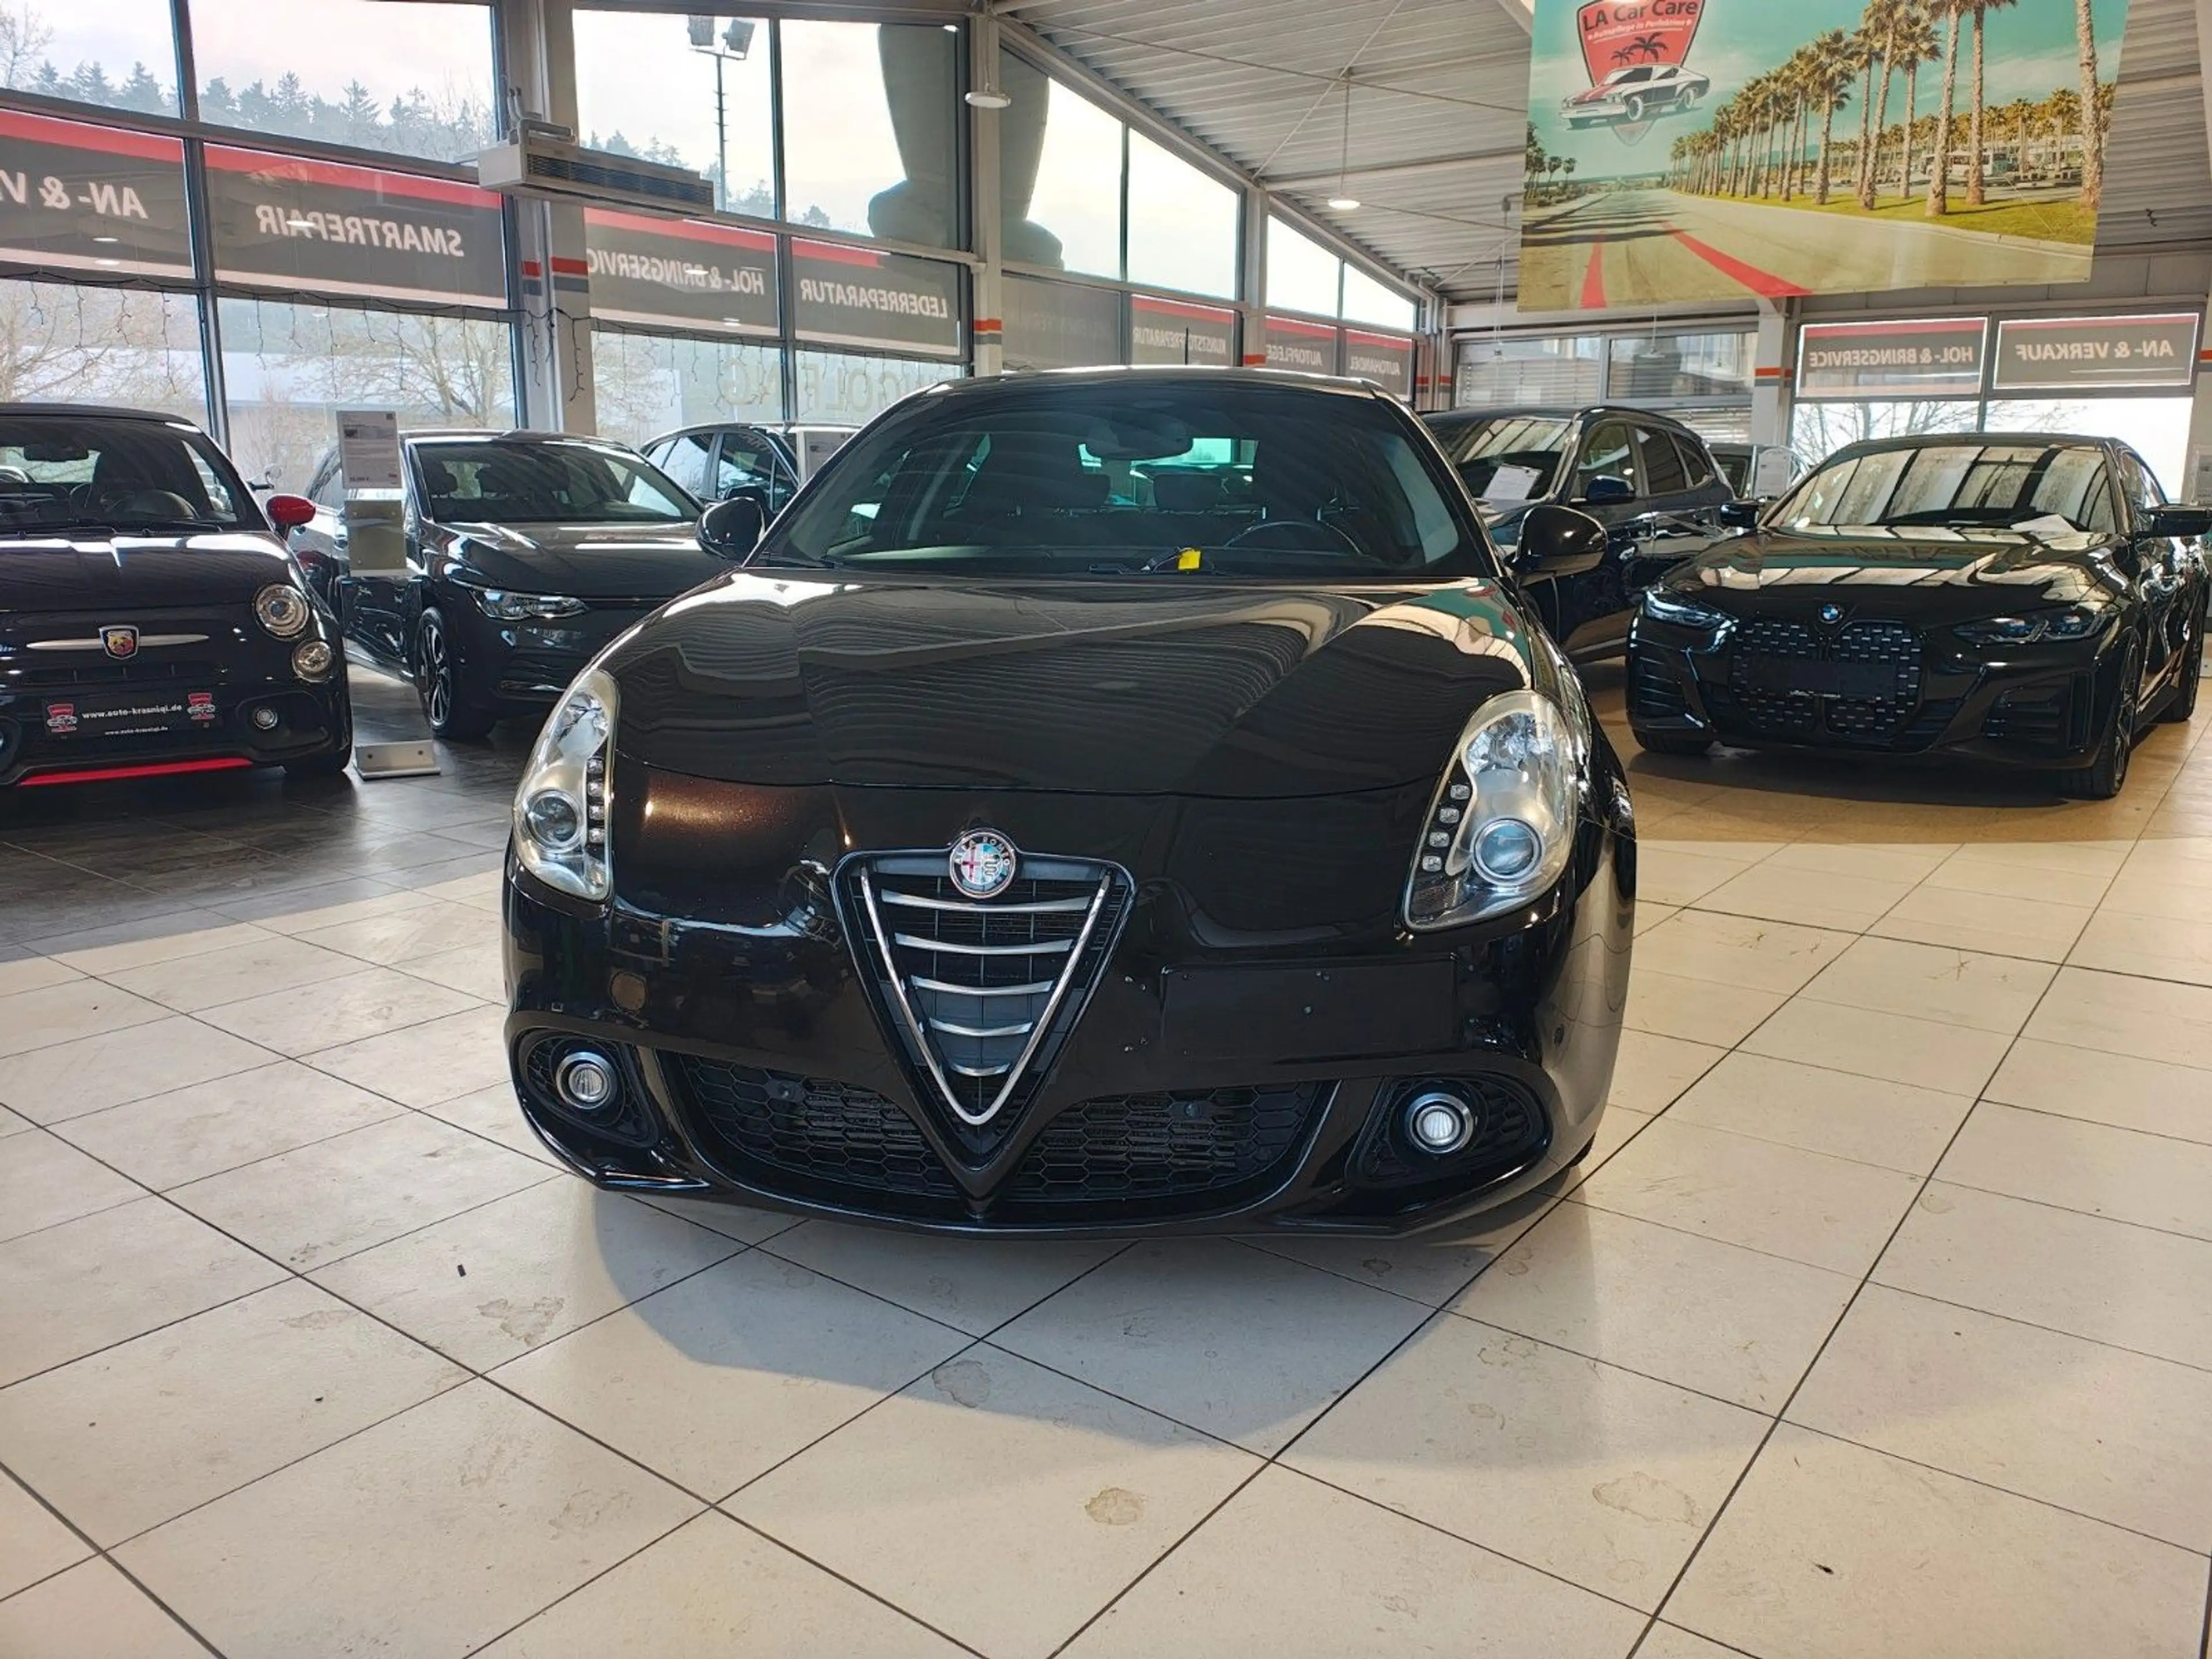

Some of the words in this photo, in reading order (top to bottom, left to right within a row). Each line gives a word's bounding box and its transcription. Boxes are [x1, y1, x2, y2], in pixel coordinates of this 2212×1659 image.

[1583, 9, 1608, 31] LA
[1614, 4, 1646, 22] Car
[1652, 0, 1698, 16] Care
